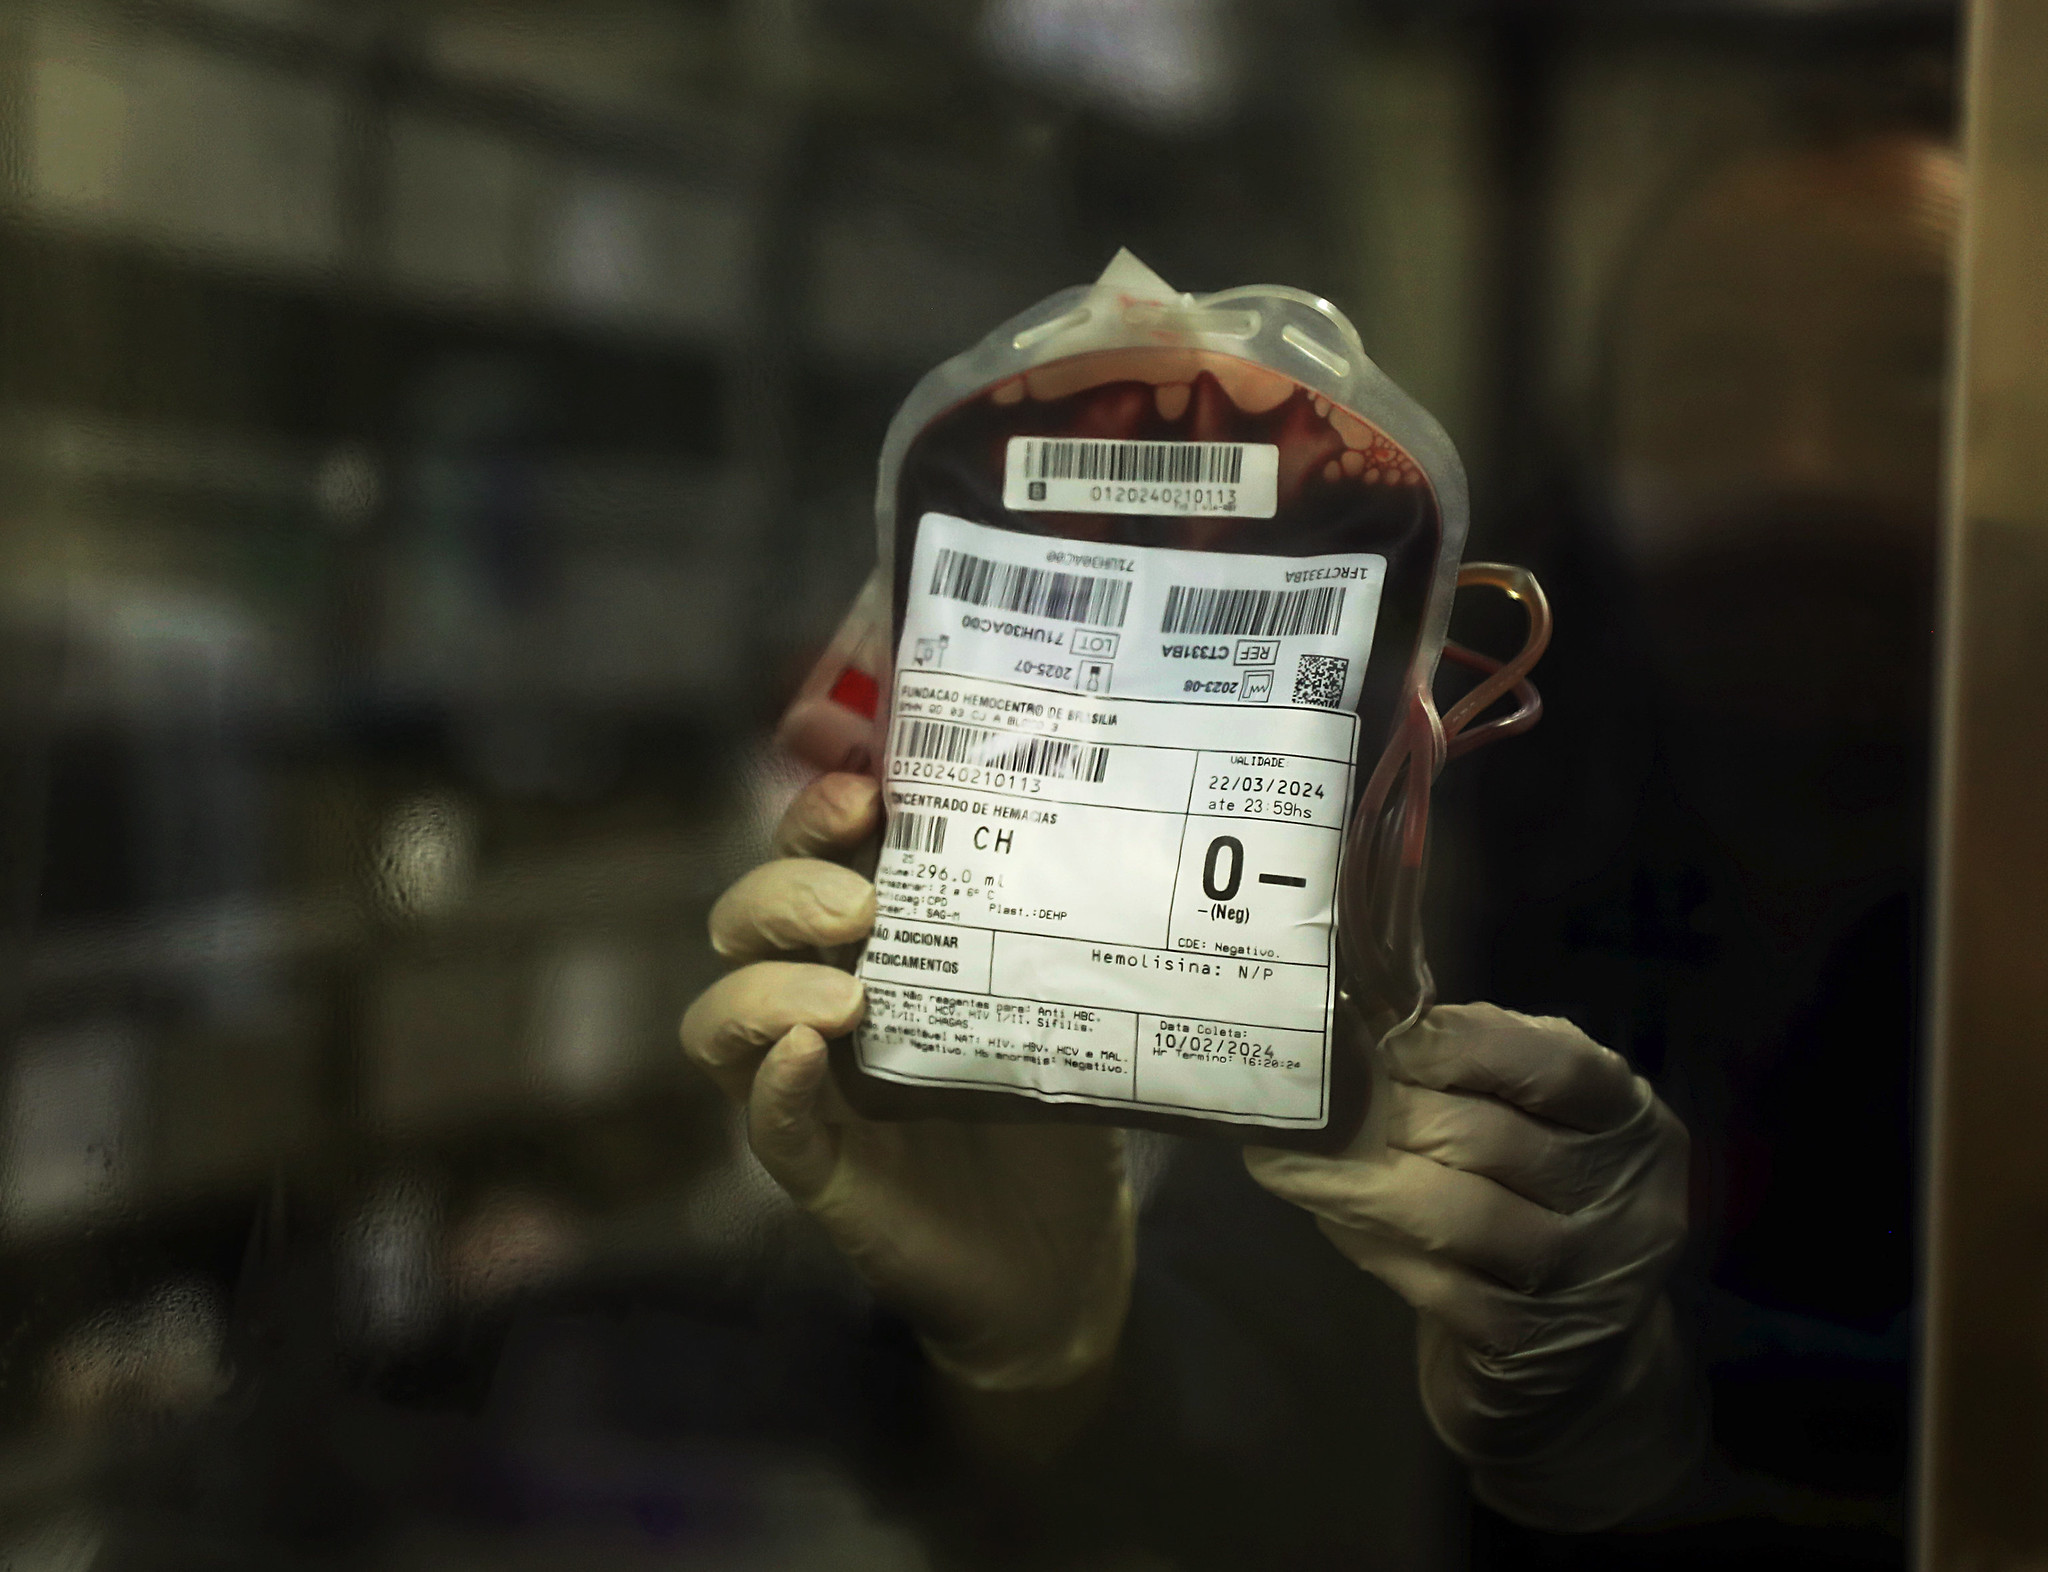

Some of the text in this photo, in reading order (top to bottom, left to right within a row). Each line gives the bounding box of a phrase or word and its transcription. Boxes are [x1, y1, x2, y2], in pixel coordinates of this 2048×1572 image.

[1091, 486, 1237, 503] 0120240210113
[1285, 567, 1368, 583] 1FRCT331BA
[1080, 637, 1112, 650] LOT
[1162, 645, 1229, 660] CT331BA
[1240, 646, 1271, 660] REF
[1014, 660, 1072, 680] 2025-07
[963, 693, 1043, 716] HEMOCENTRO
[1048, 706, 1063, 719] DE
[1067, 710, 1117, 725] BRSILIA
[893, 760, 1042, 793] 0120240210113
[1209, 776, 1324, 799] 22/03/2024
[972, 804, 987, 815] DE
[1208, 797, 1312, 818] ate 23:59hs
[973, 826, 1014, 854] CH
[894, 929, 959, 948] ADICIONAR
[1178, 938, 1280, 959] CDE: Negativo.
[866, 951, 959, 974] MEDICAMENTOS
[1092, 949, 1274, 981] Hemolisina: N/P
[1038, 1007, 1065, 1018] Anti
[1160, 1021, 1248, 1038] Data Coleta:
[1057, 1045, 1079, 1056] HCV
[1085, 1050, 1093, 1058] e
[1155, 1033, 1274, 1058] 10/02/2024
[1153, 1047, 1167, 1056] Hr
[1176, 1049, 1232, 1063] Termino:
[1064, 1059, 1128, 1074] Negativo.
